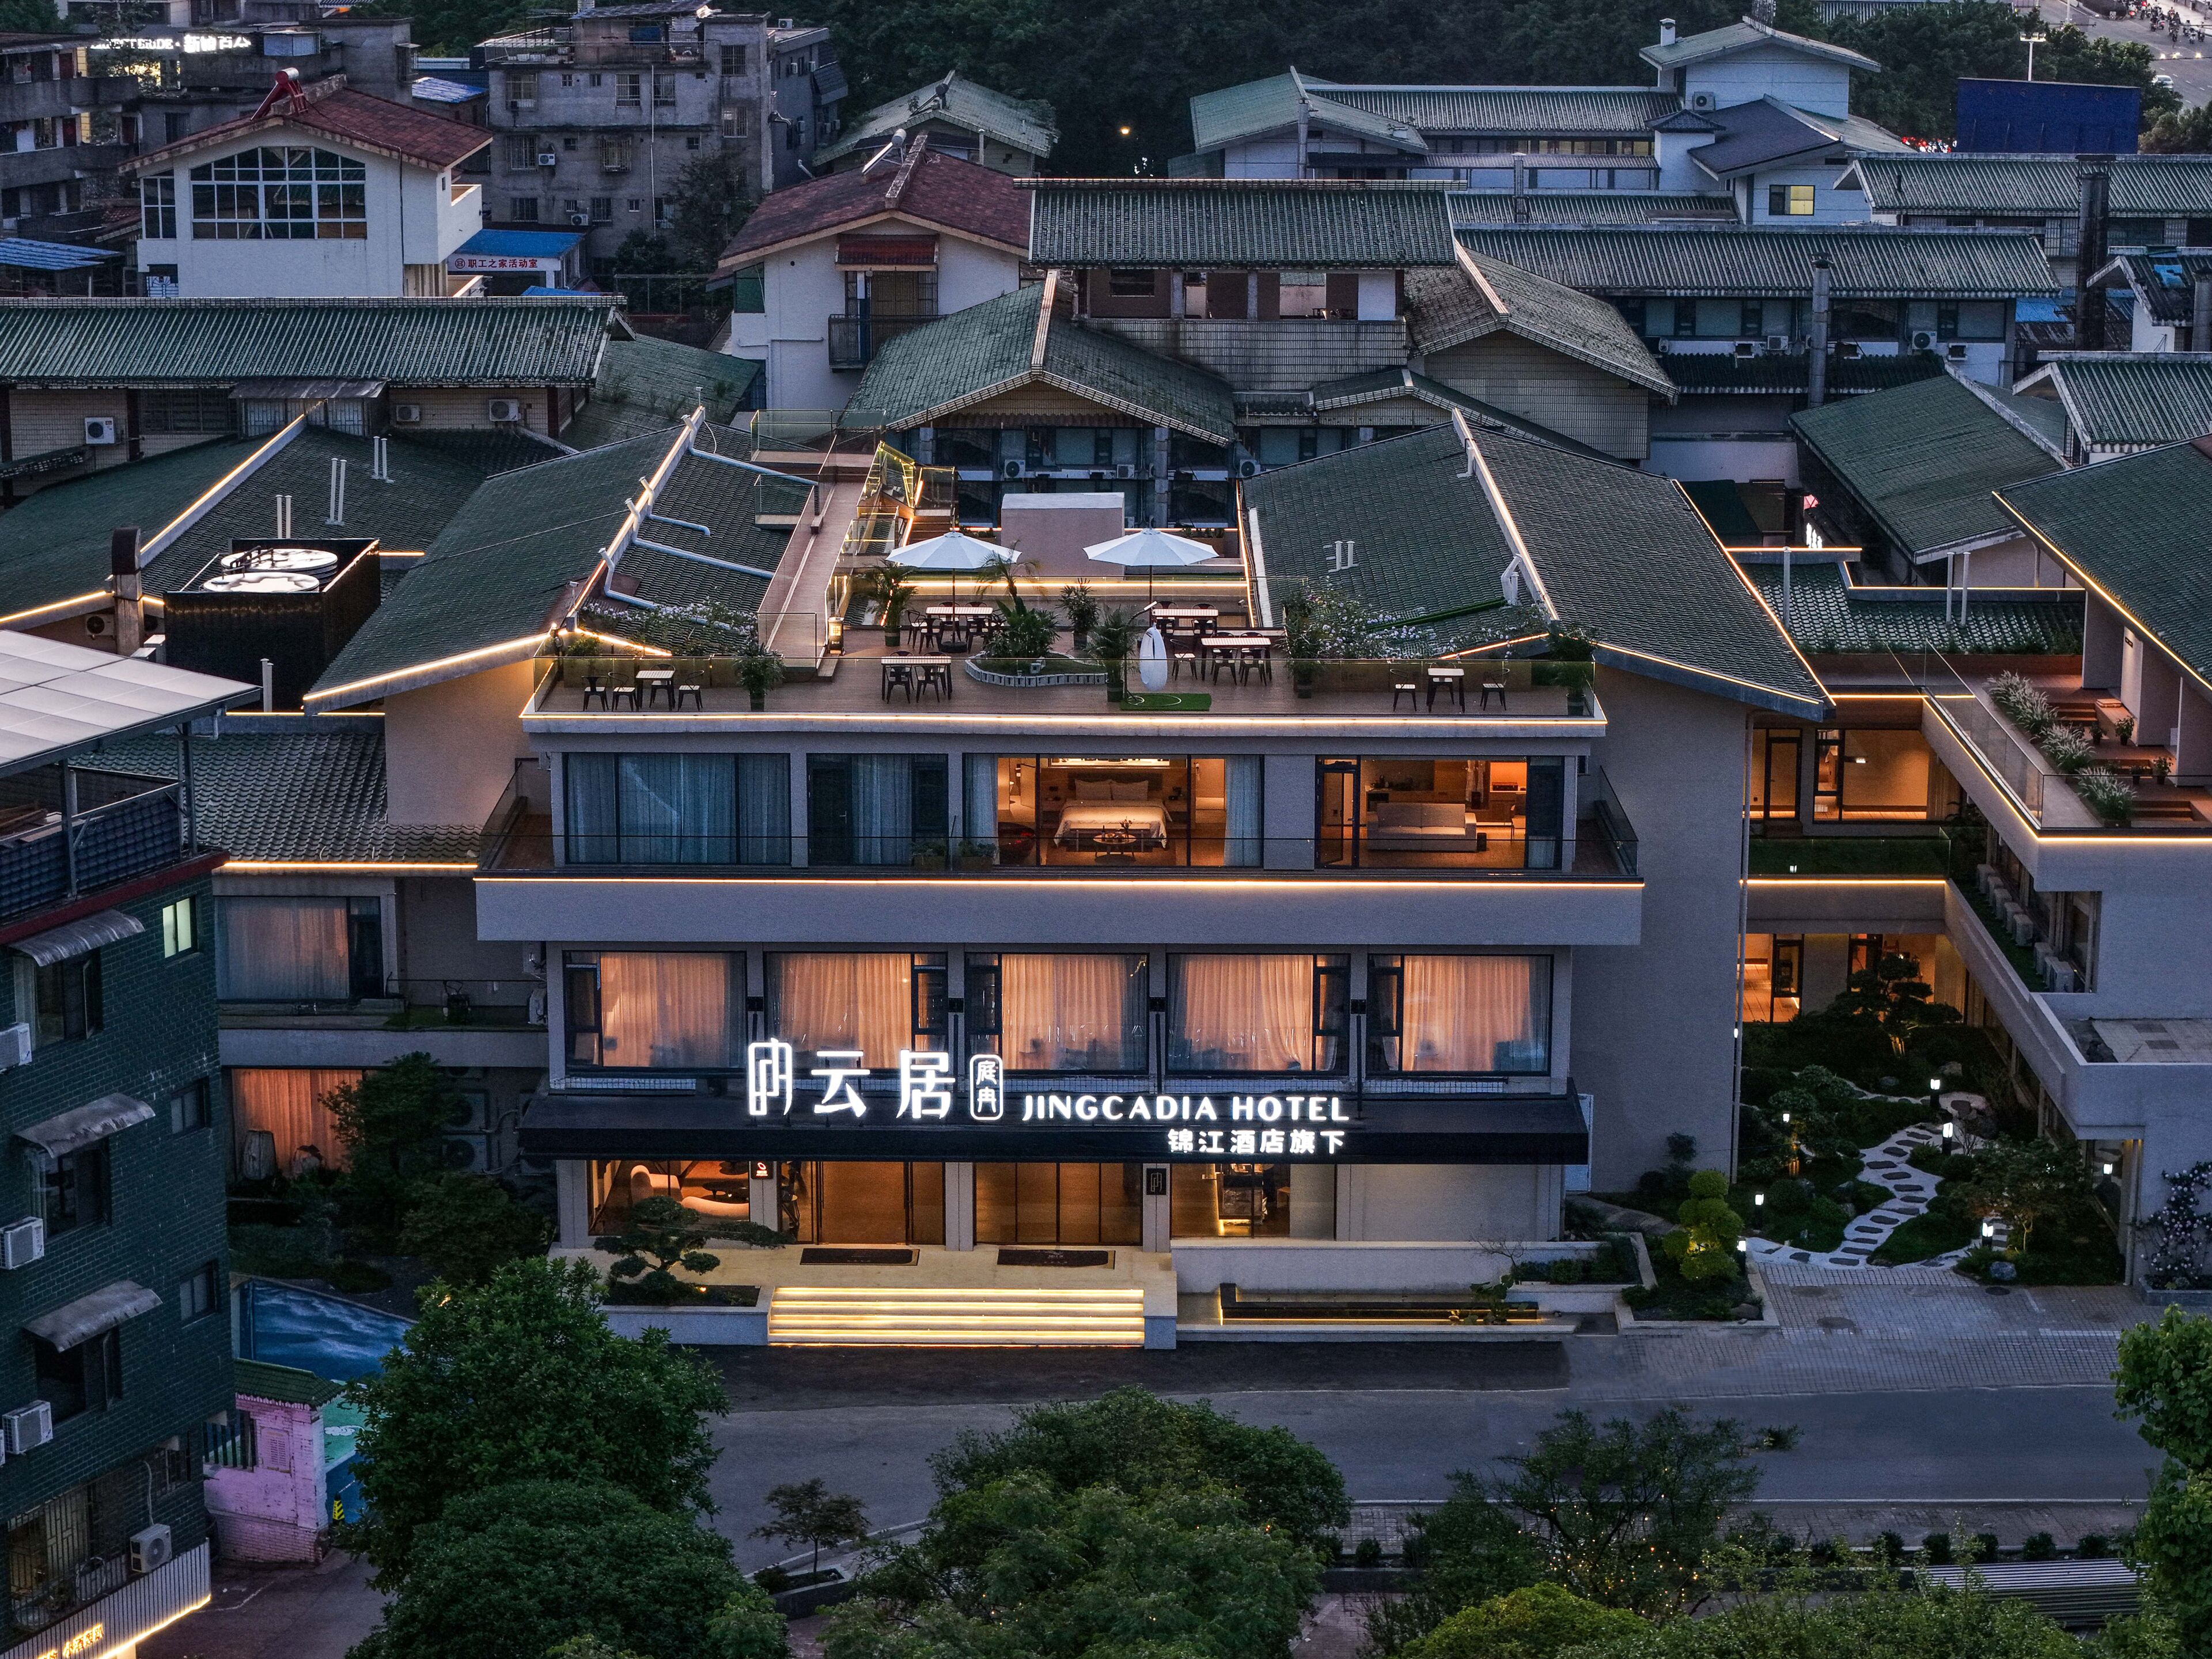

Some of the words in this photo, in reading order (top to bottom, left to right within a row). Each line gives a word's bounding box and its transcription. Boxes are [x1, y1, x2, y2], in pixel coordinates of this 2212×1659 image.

[468, 259, 538, 268] 职工之家活动室
[1022, 1095, 1217, 1121] JINGCADIA
[1232, 1096, 1349, 1121] HOTEL
[1167, 1128, 1345, 1154] 锦江酒店旗下
